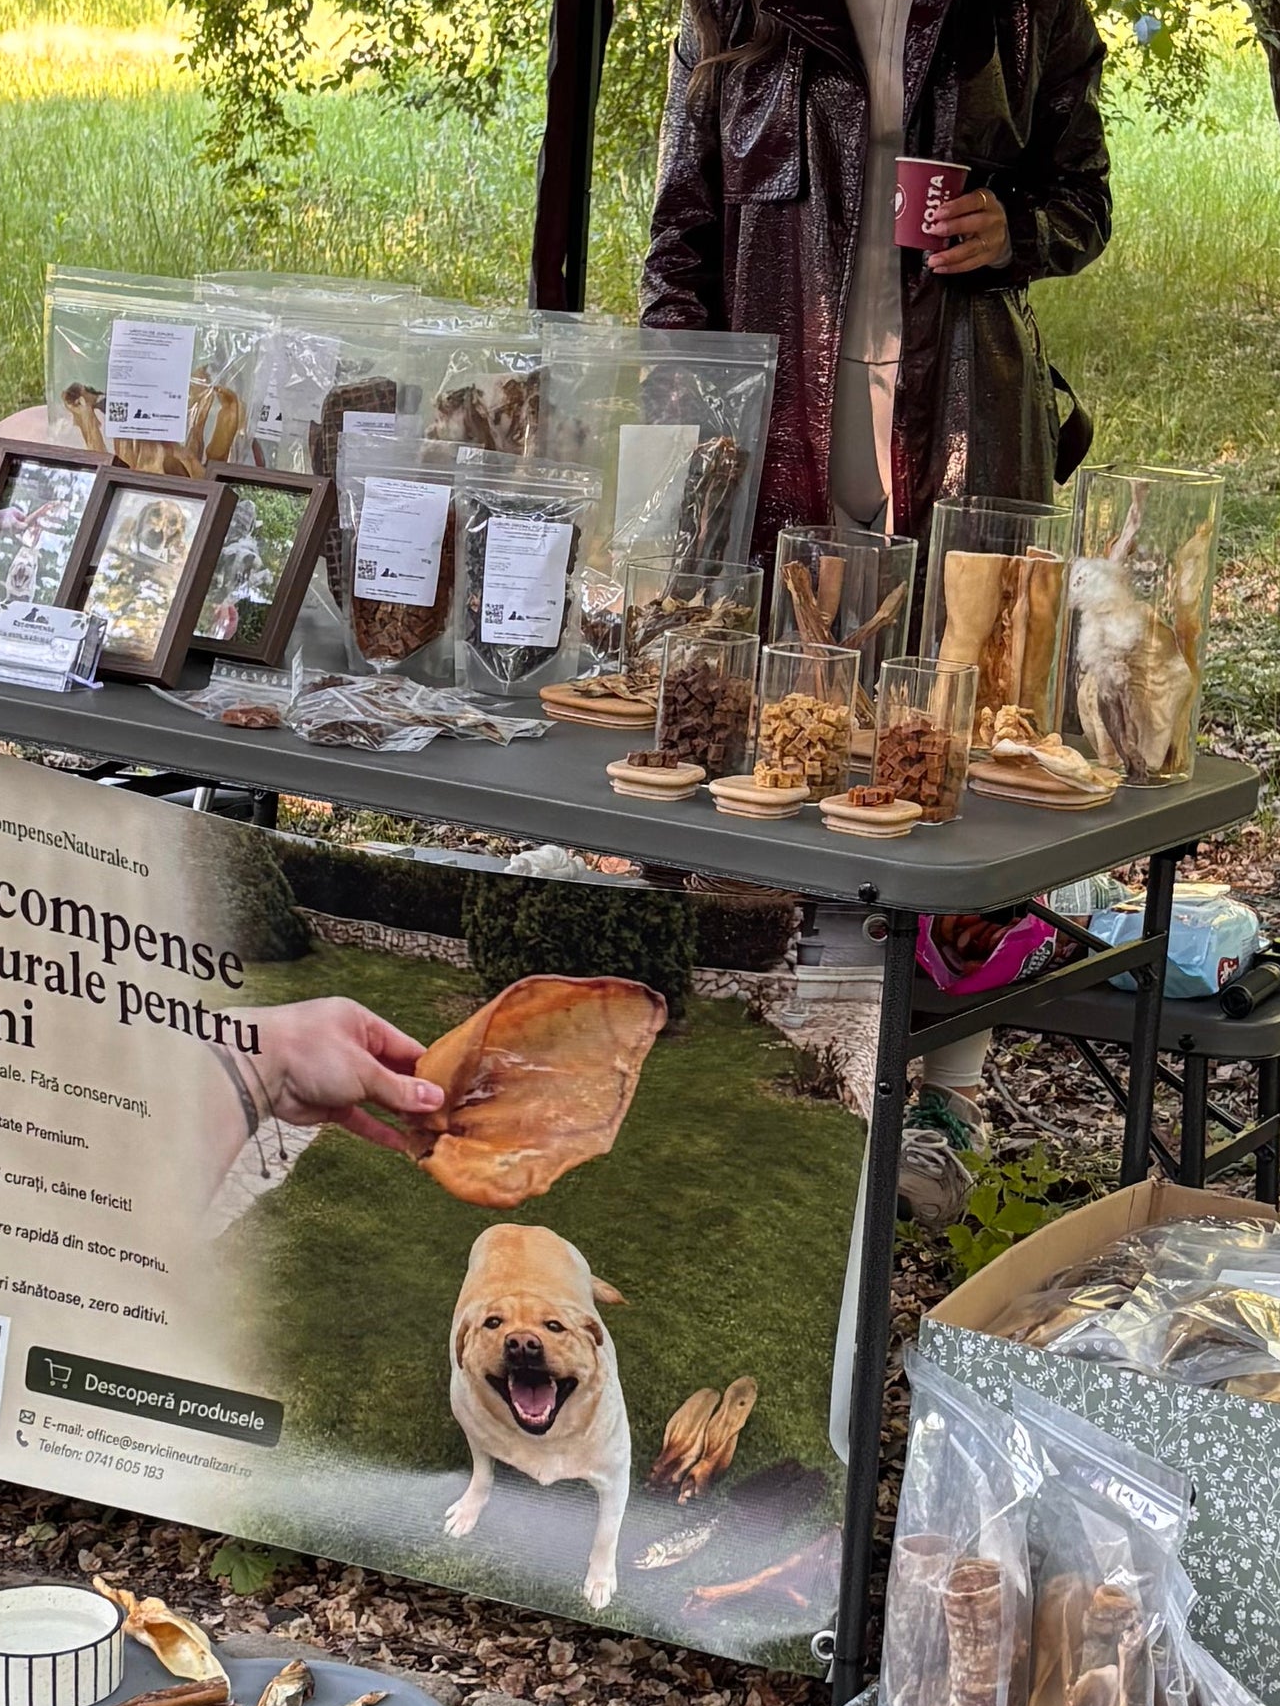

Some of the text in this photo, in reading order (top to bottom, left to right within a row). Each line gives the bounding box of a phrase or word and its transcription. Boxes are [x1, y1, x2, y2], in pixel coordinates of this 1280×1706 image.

[117, 980, 262, 1054] pentru
[30, 1070, 59, 1092] Fără
[64, 1083, 151, 1118] conservanți.
[26, 1122, 89, 1149] Premium.
[51, 1180, 87, 1200] câine
[90, 1188, 132, 1212] fericit!
[15, 1225, 59, 1244] rapidă
[63, 1234, 84, 1250] din
[87, 1240, 116, 1257] stoc
[119, 1249, 169, 1274] propriu.
[12, 1280, 85, 1308] sănătoase,
[89, 1298, 119, 1314] zero
[122, 1302, 168, 1325] aditivi.
[85, 1373, 265, 1430] Descoperă produsele
[39, 1438, 164, 1480] Telefon: 0741 605 183
[43, 1416, 253, 1478] E-mail: office@serviciineutralizari.ro
